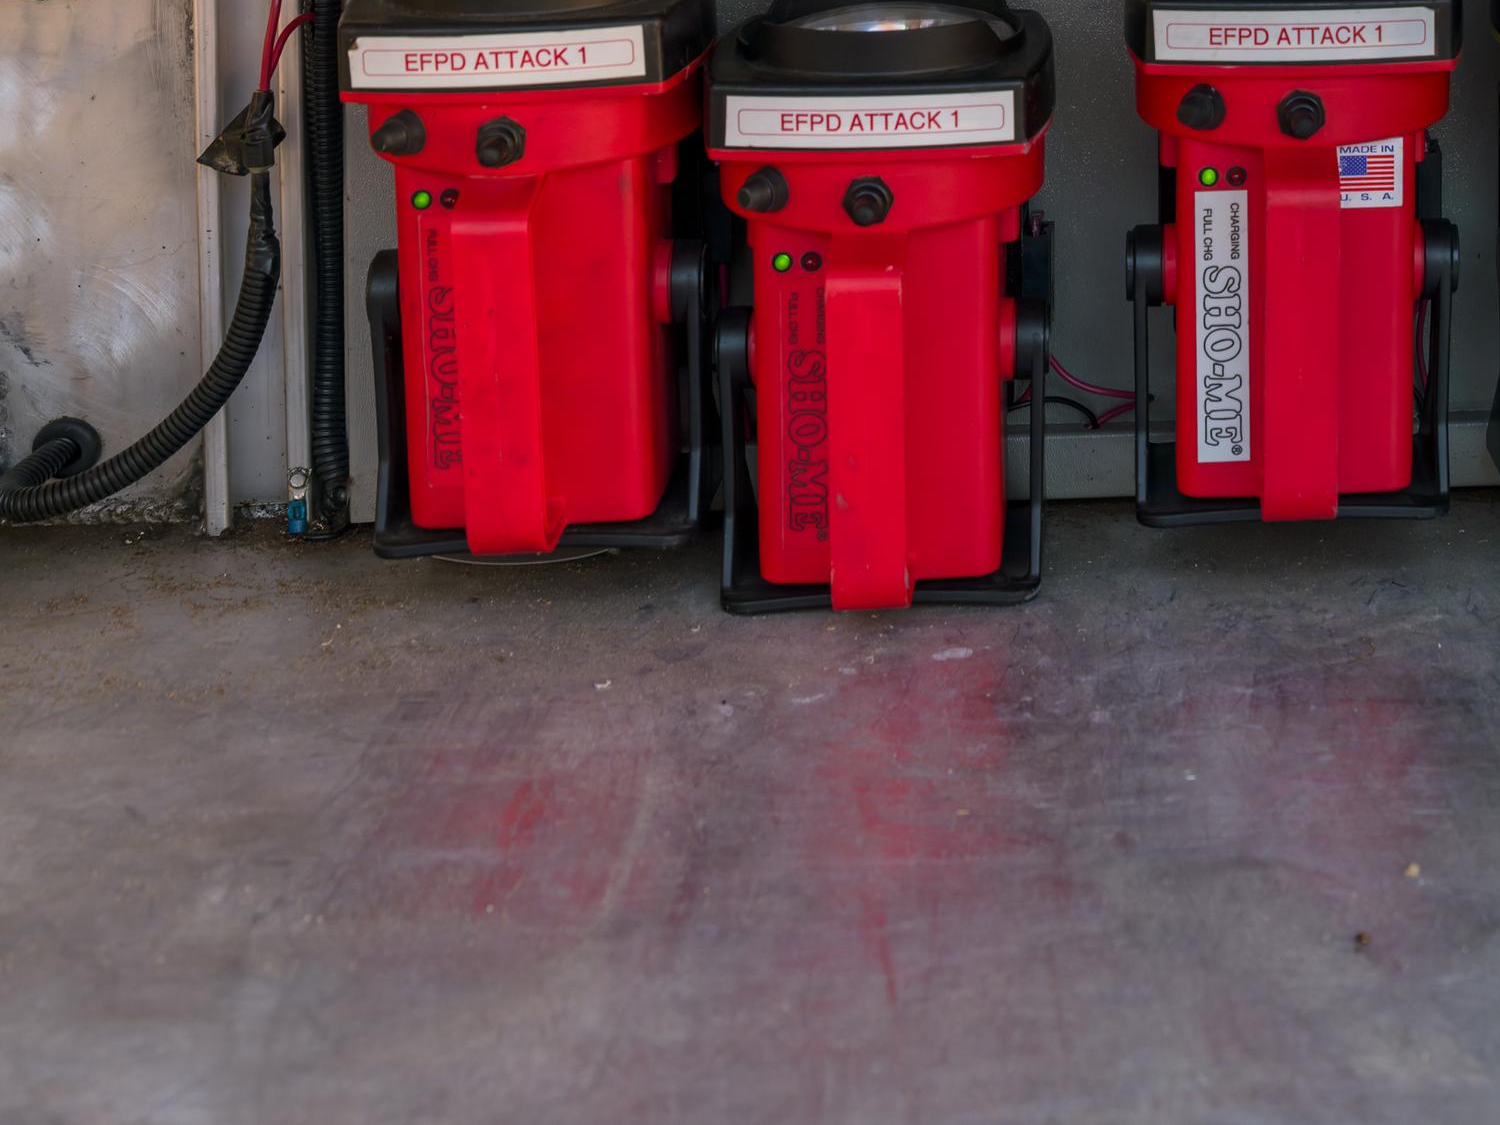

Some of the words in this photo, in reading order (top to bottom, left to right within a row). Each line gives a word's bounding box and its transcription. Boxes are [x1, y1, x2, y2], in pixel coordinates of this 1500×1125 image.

[1209, 27, 1269, 45] EFPD
[1277, 25, 1367, 45] ATTACK
[1374, 25, 1383, 42] 1
[404, 53, 466, 72] EFPD
[474, 48, 568, 70] ATTACK
[578, 47, 587, 64] 1
[780, 113, 841, 132] EFPD
[850, 111, 941, 132] ATTACK
[951, 110, 959, 128] 1
[1339, 146, 1377, 154] MADE
[1381, 145, 1394, 153] IN
[1203, 208, 1213, 235] FULL
[1230, 202, 1241, 260] CHARGING
[1203, 237, 1213, 261] CHG
[788, 292, 799, 317] FULL
